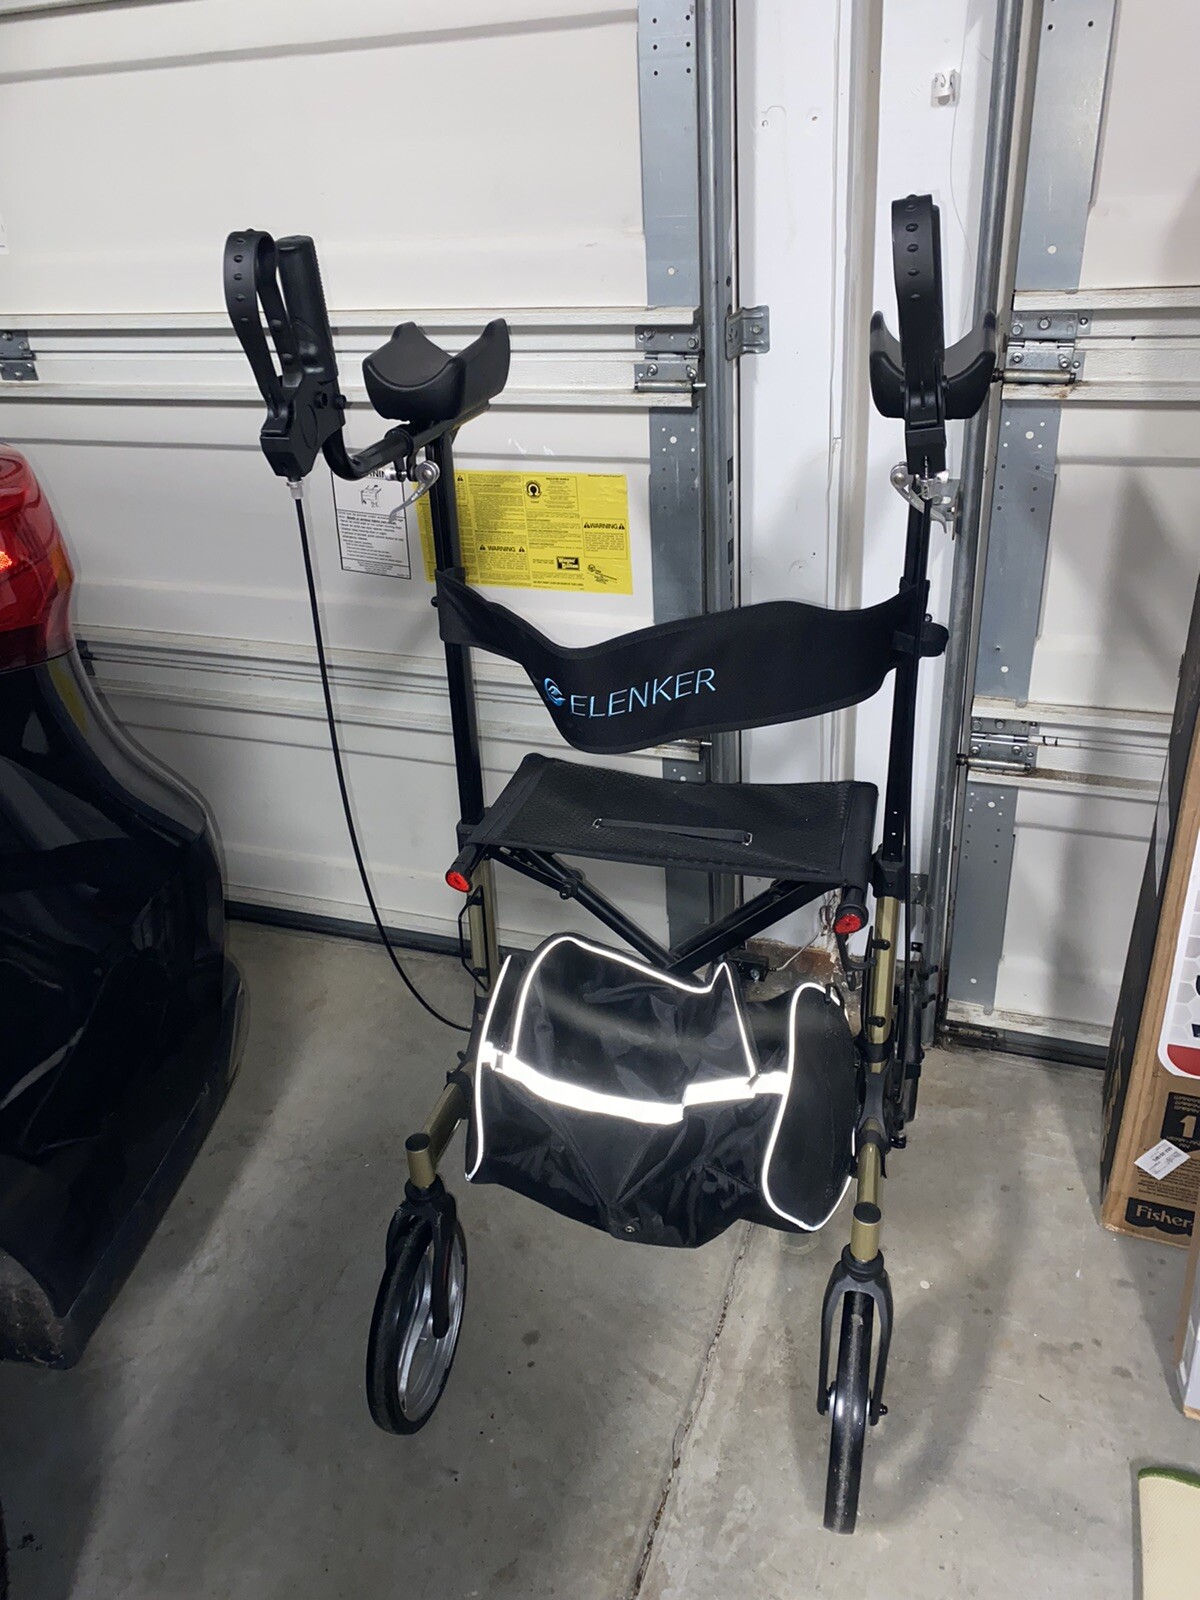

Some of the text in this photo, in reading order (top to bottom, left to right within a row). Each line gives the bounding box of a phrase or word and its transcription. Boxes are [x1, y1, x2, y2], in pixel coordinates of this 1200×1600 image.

[589, 522, 618, 530] WARNING
[487, 545, 516, 553] WARNING
[570, 667, 717, 719] ELENKER
[1179, 1115, 1197, 1139] 1
